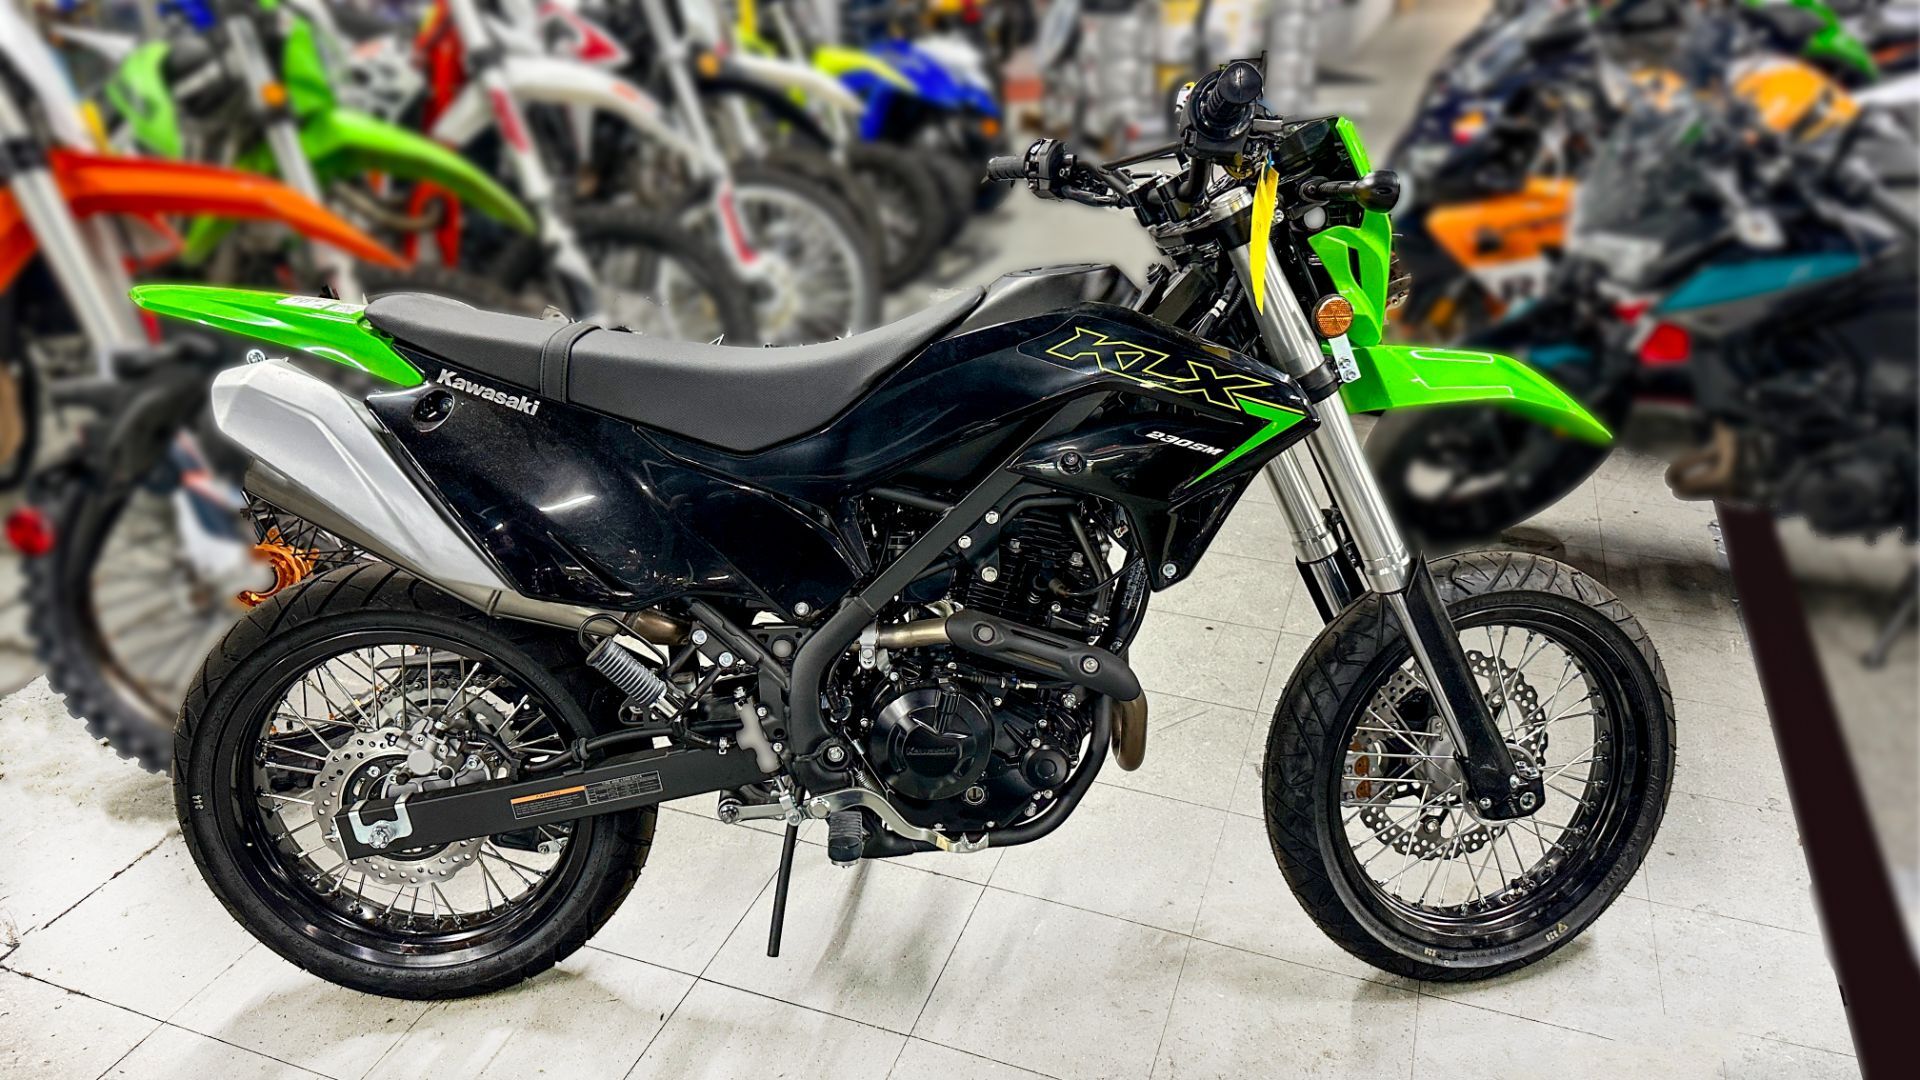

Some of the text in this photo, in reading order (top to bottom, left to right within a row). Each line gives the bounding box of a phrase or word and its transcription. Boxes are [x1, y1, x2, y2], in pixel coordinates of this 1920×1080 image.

[436, 368, 540, 416] Kawasaki
[1046, 327, 1274, 410] KLX
[1145, 431, 1224, 455] 230SM
